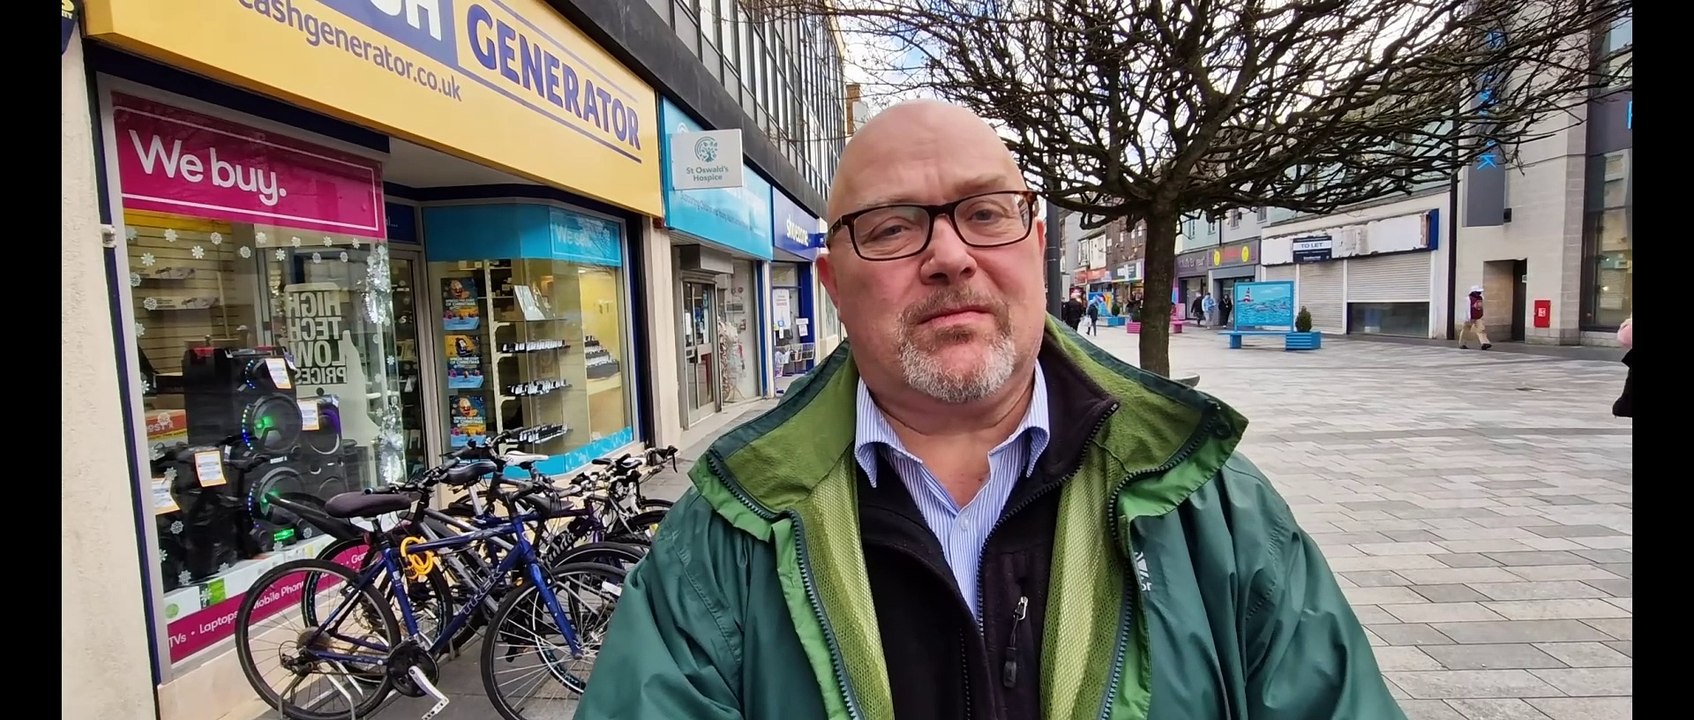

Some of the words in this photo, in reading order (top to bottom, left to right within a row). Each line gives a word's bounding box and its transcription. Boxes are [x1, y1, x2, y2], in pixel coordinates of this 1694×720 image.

[467, 4, 640, 150] GENERATOR
[128, 129, 203, 182] We
[210, 147, 287, 206] buy.
[693, 174, 722, 182] Hospice
[695, 165, 729, 174] Oswald's
[169, 633, 187, 649] TVs
[199, 611, 238, 635] Laptops
